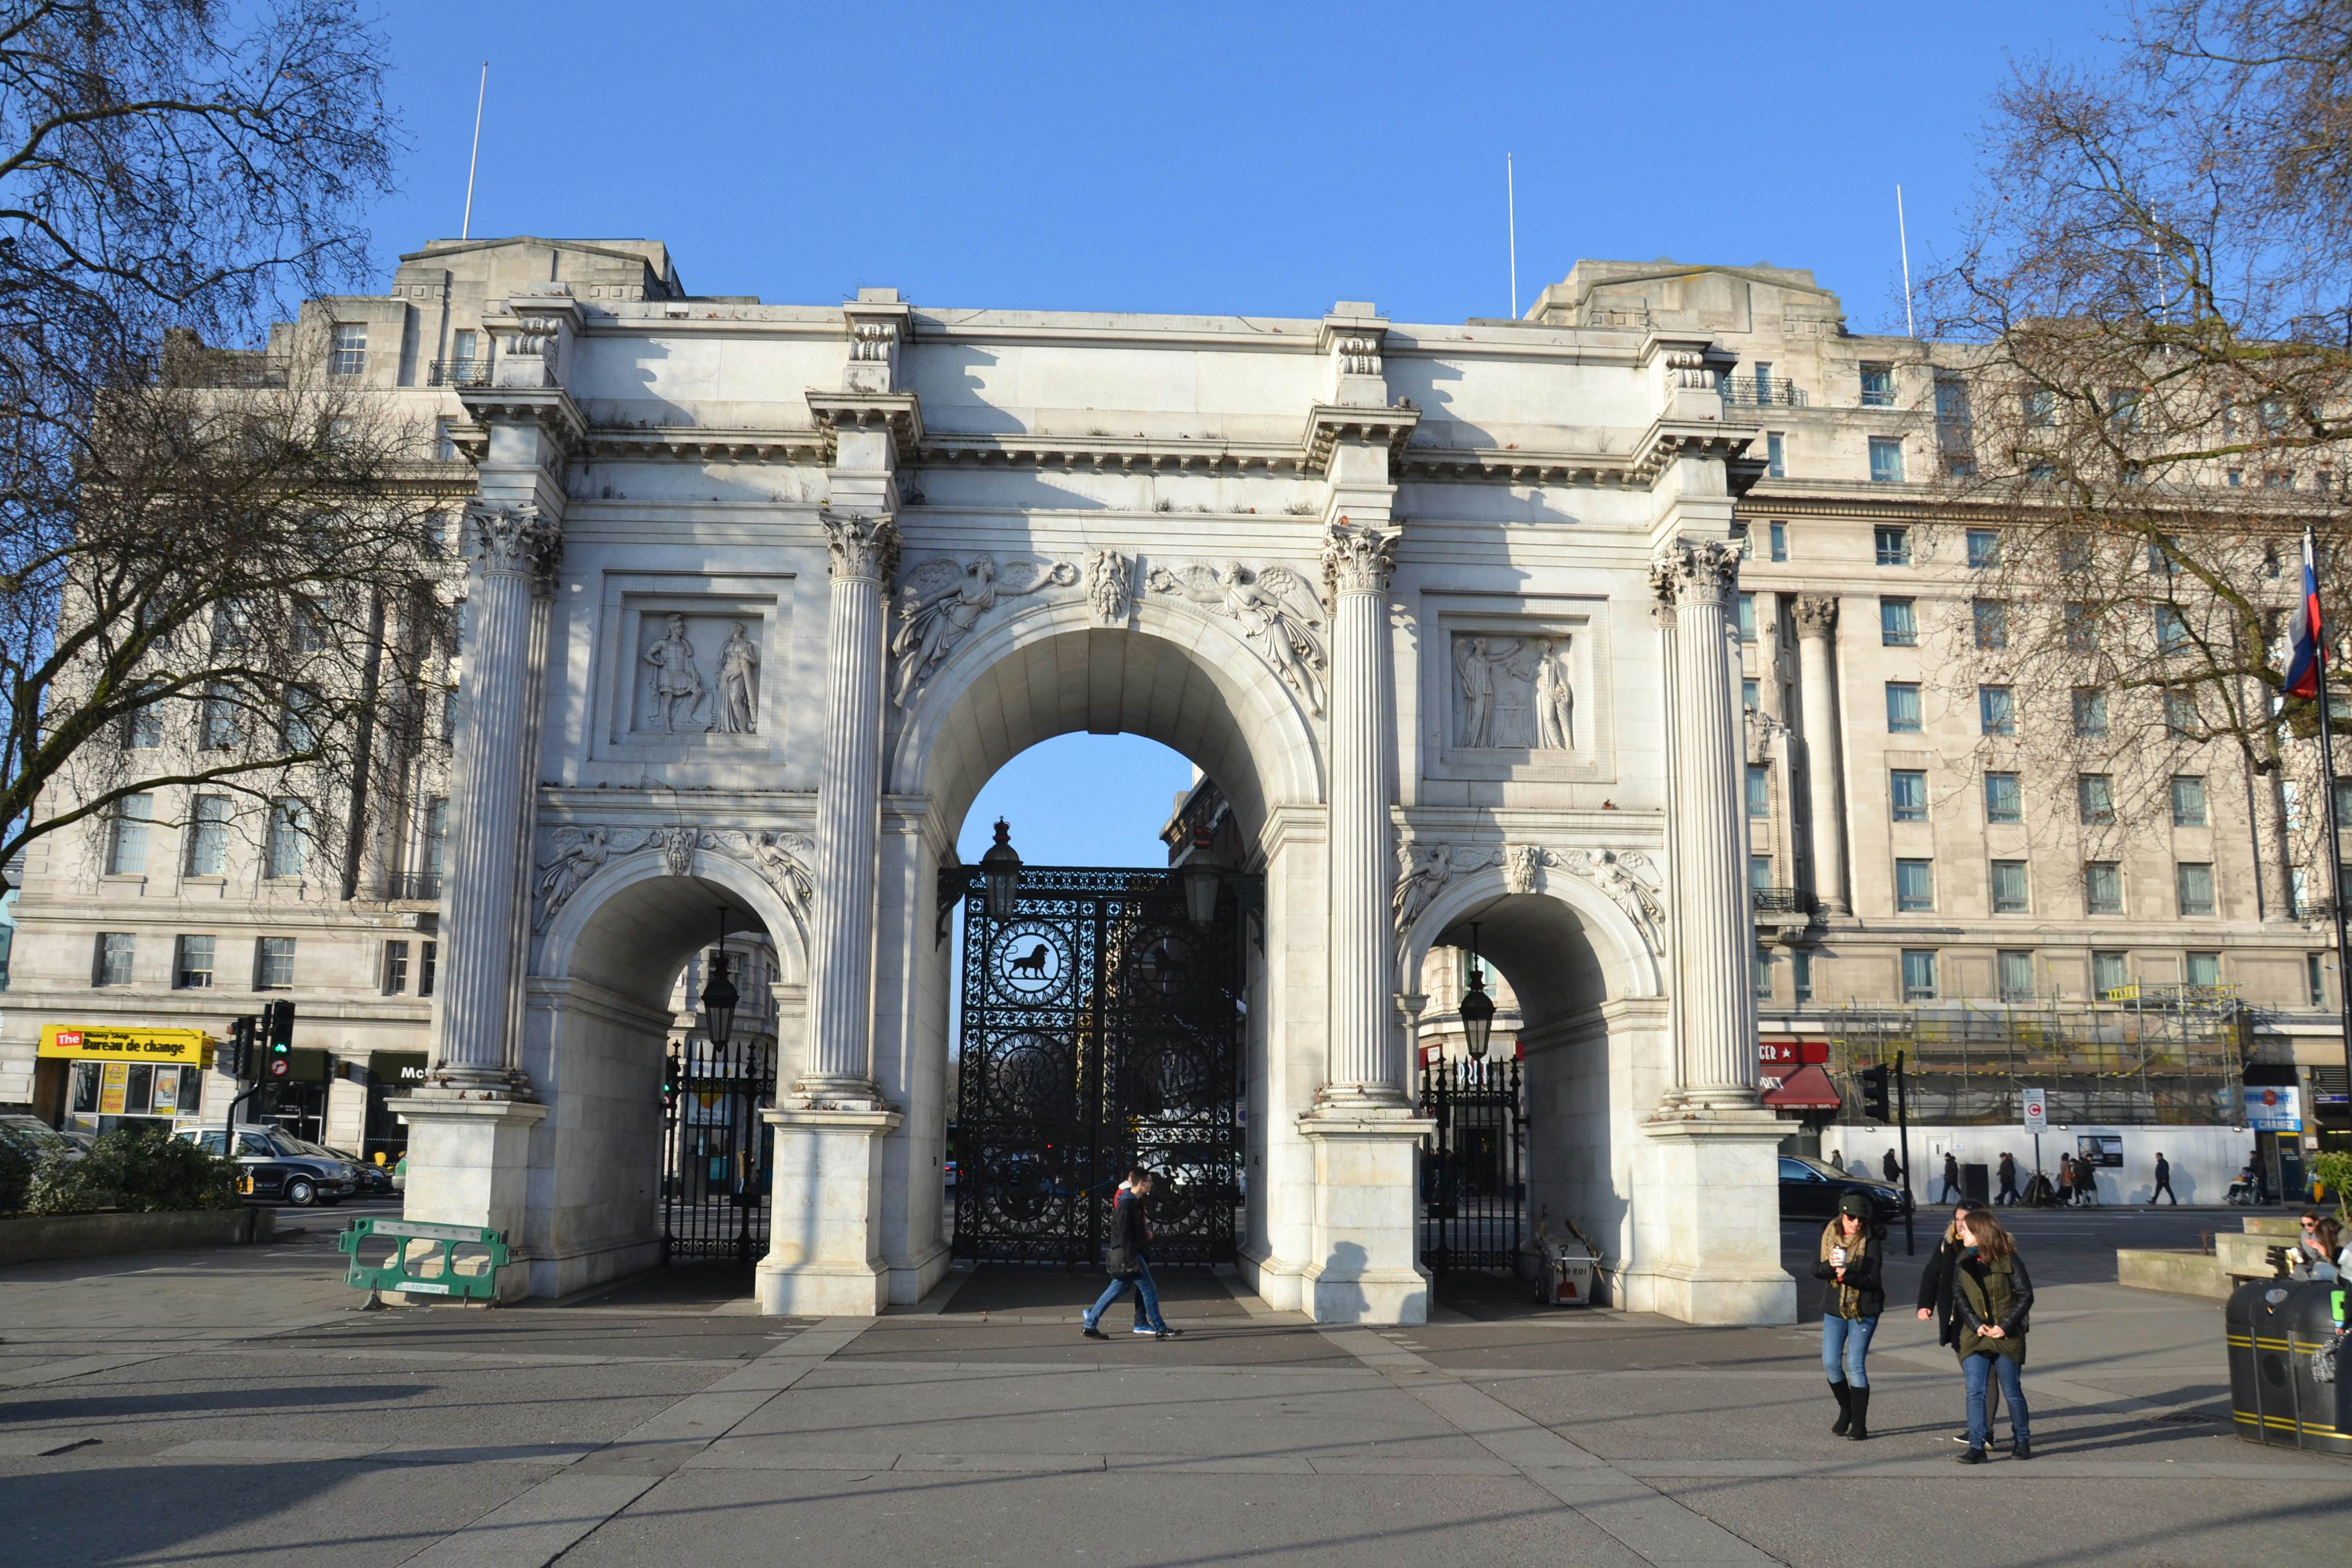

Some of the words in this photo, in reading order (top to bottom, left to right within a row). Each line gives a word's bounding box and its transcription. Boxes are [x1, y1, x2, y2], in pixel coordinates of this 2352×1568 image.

[58, 1034, 80, 1045] The
[84, 1032, 109, 1040] Money
[111, 1032, 130, 1040] Shop
[82, 1038, 124, 1051] Bureau
[126, 1039, 140, 1052] de
[143, 1039, 185, 1057] change
[104, 1101, 121, 1110] 10pm
[2258, 1120, 2295, 1130] CHANGE
